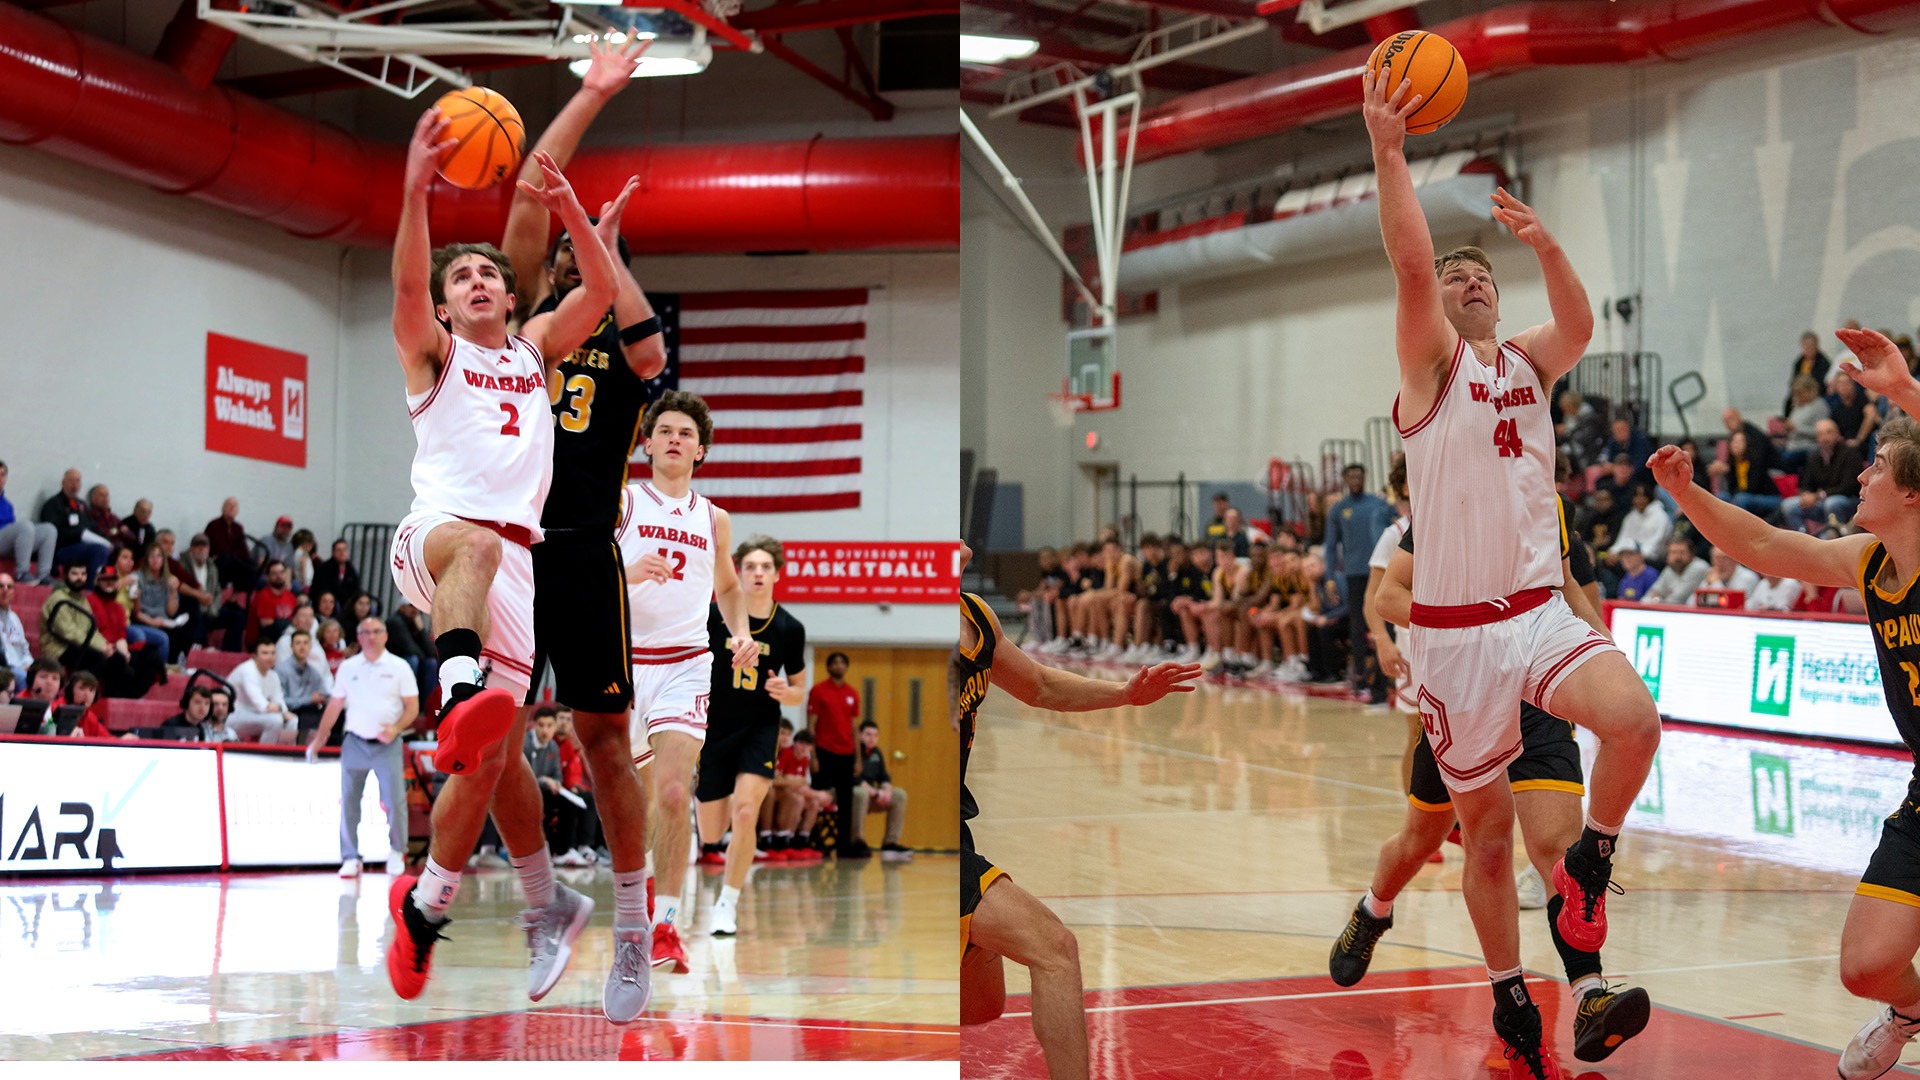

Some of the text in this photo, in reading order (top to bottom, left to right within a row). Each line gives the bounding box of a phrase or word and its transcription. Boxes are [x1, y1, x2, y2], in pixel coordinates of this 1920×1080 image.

[1382, 31, 1421, 68] Wilso
[216, 365, 271, 405] Always
[1469, 381, 1537, 415] WBASH
[214, 394, 276, 431] Wabash.
[500, 403, 520, 436] 2
[1493, 418, 1523, 458] 44
[638, 525, 708, 551] WABASH
[786, 549, 936, 560] NCAA DIVISION III
[786, 561, 937, 578] BASKETBALL
[733, 659, 759, 690] 15
[1800, 686, 1842, 704] Regional
